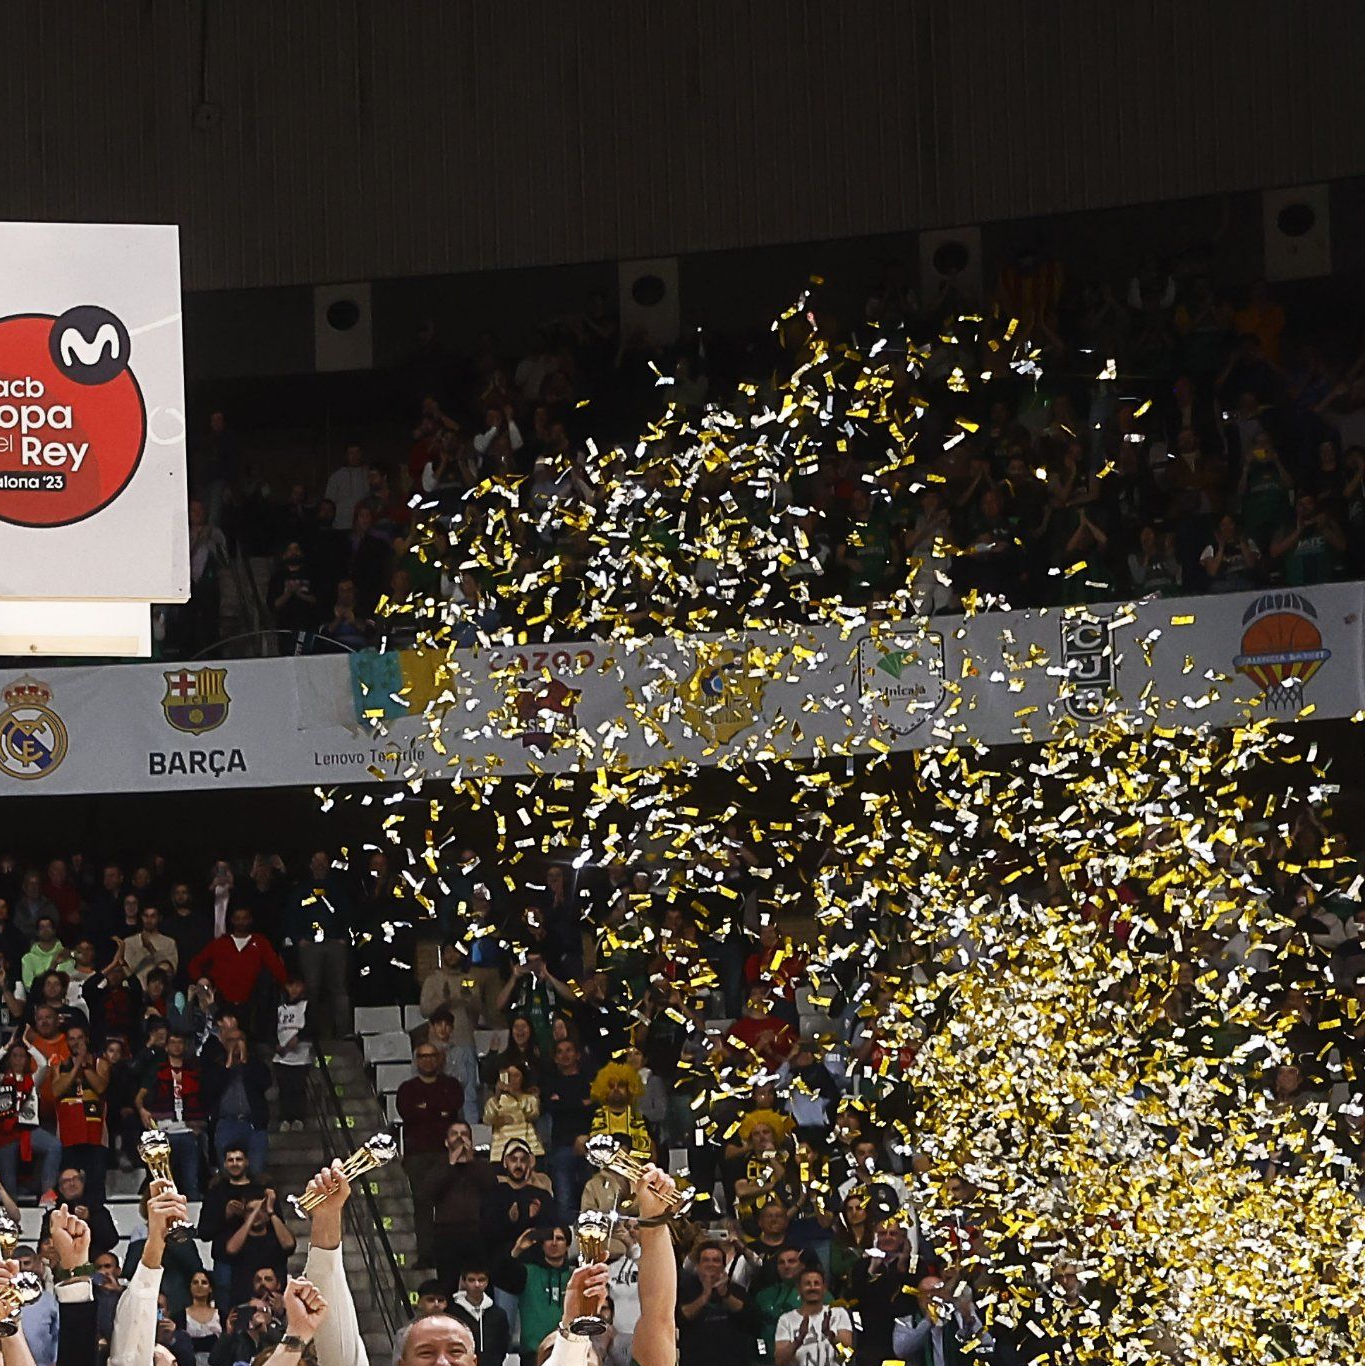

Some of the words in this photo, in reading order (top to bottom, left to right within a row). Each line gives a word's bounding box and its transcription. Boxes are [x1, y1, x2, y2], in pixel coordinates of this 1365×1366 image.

[21, 436, 89, 472] Rey
[42, 475, 64, 489] '23
[149, 748, 247, 778] BARÇA
[315, 751, 365, 766] Lenovo
[370, 748, 425, 761] Terife
